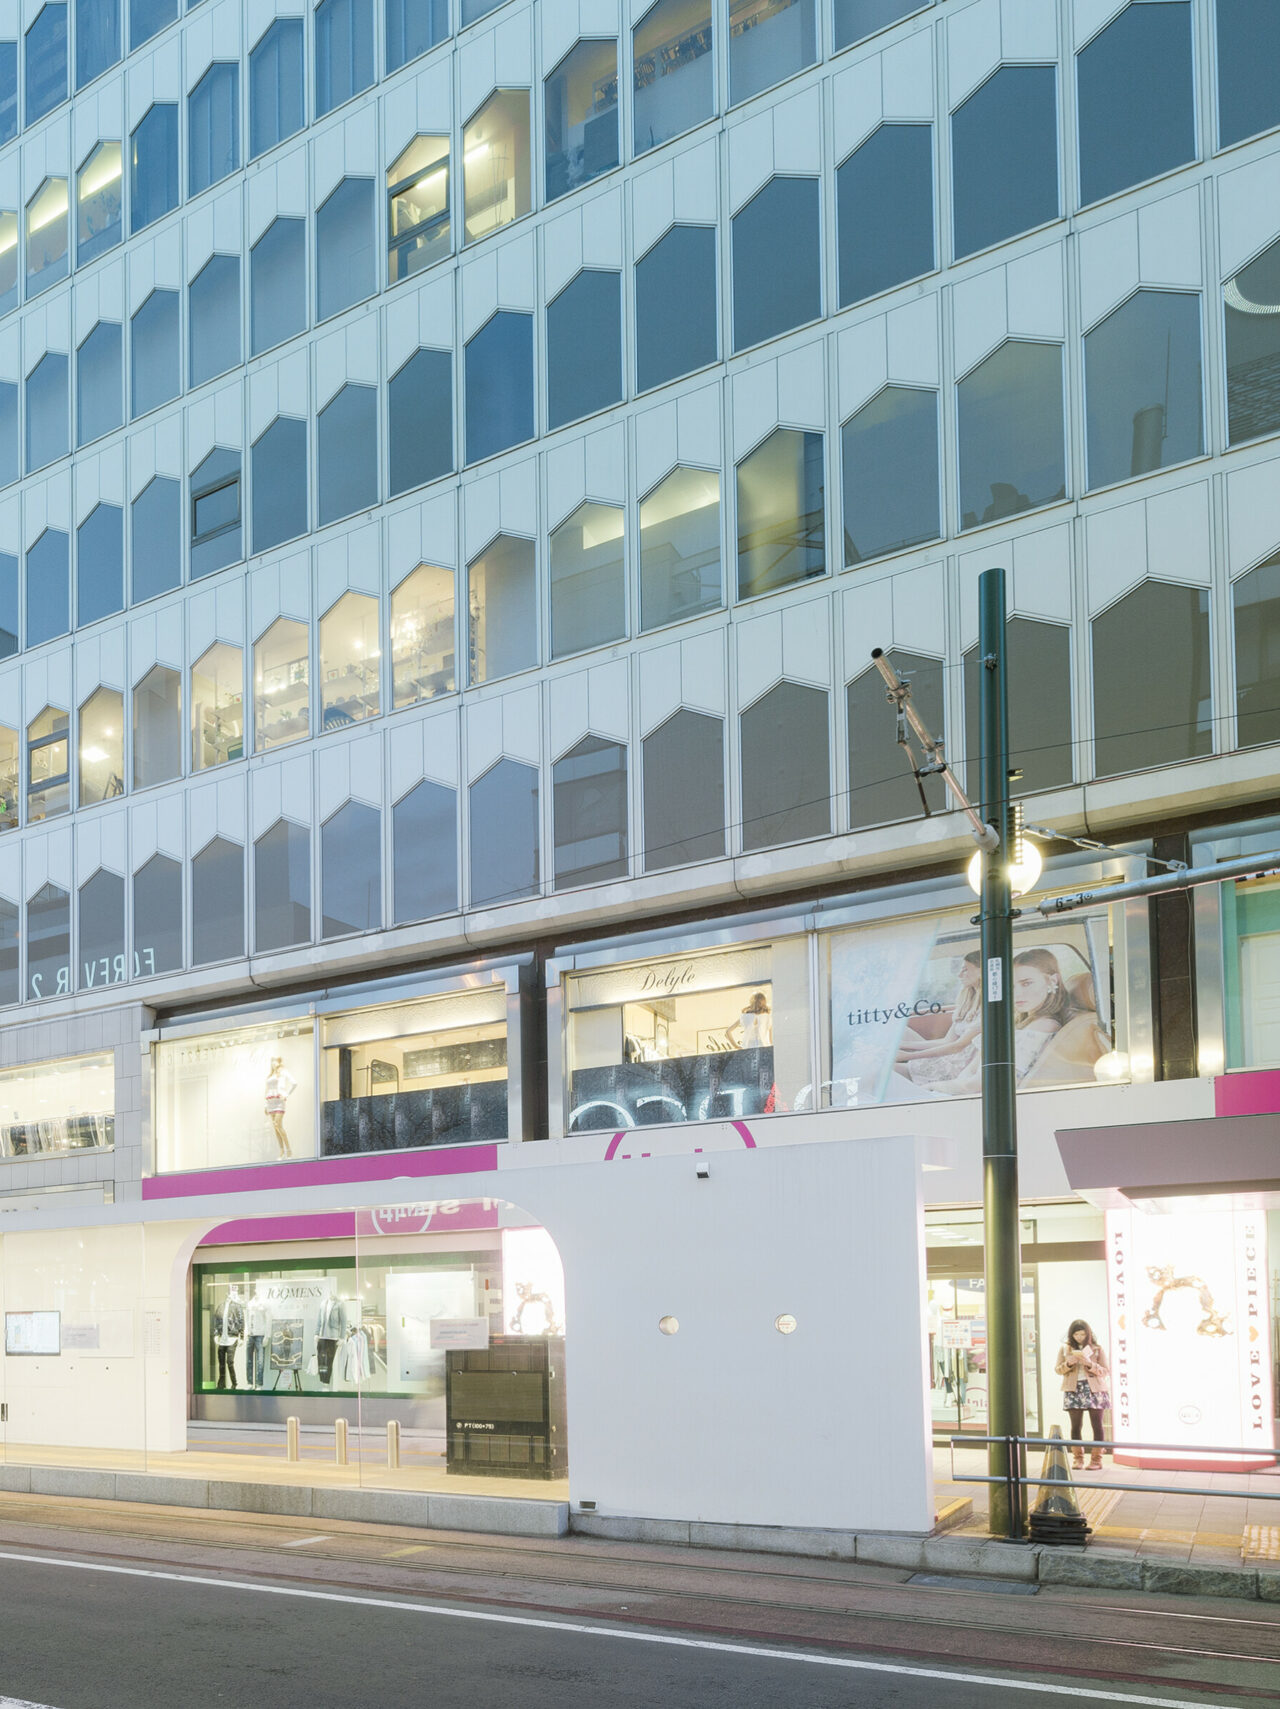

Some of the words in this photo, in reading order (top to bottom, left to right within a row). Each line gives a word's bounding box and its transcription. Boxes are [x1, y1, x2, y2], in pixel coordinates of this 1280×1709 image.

[640, 965, 696, 994] Delyle
[847, 998, 947, 1027] titty&Co.
[1114, 1231, 1126, 1308] LOVE
[1245, 1224, 1258, 1317] PIECE
[1118, 1338, 1130, 1428] PIECE
[1249, 1350, 1263, 1431] LOVE
